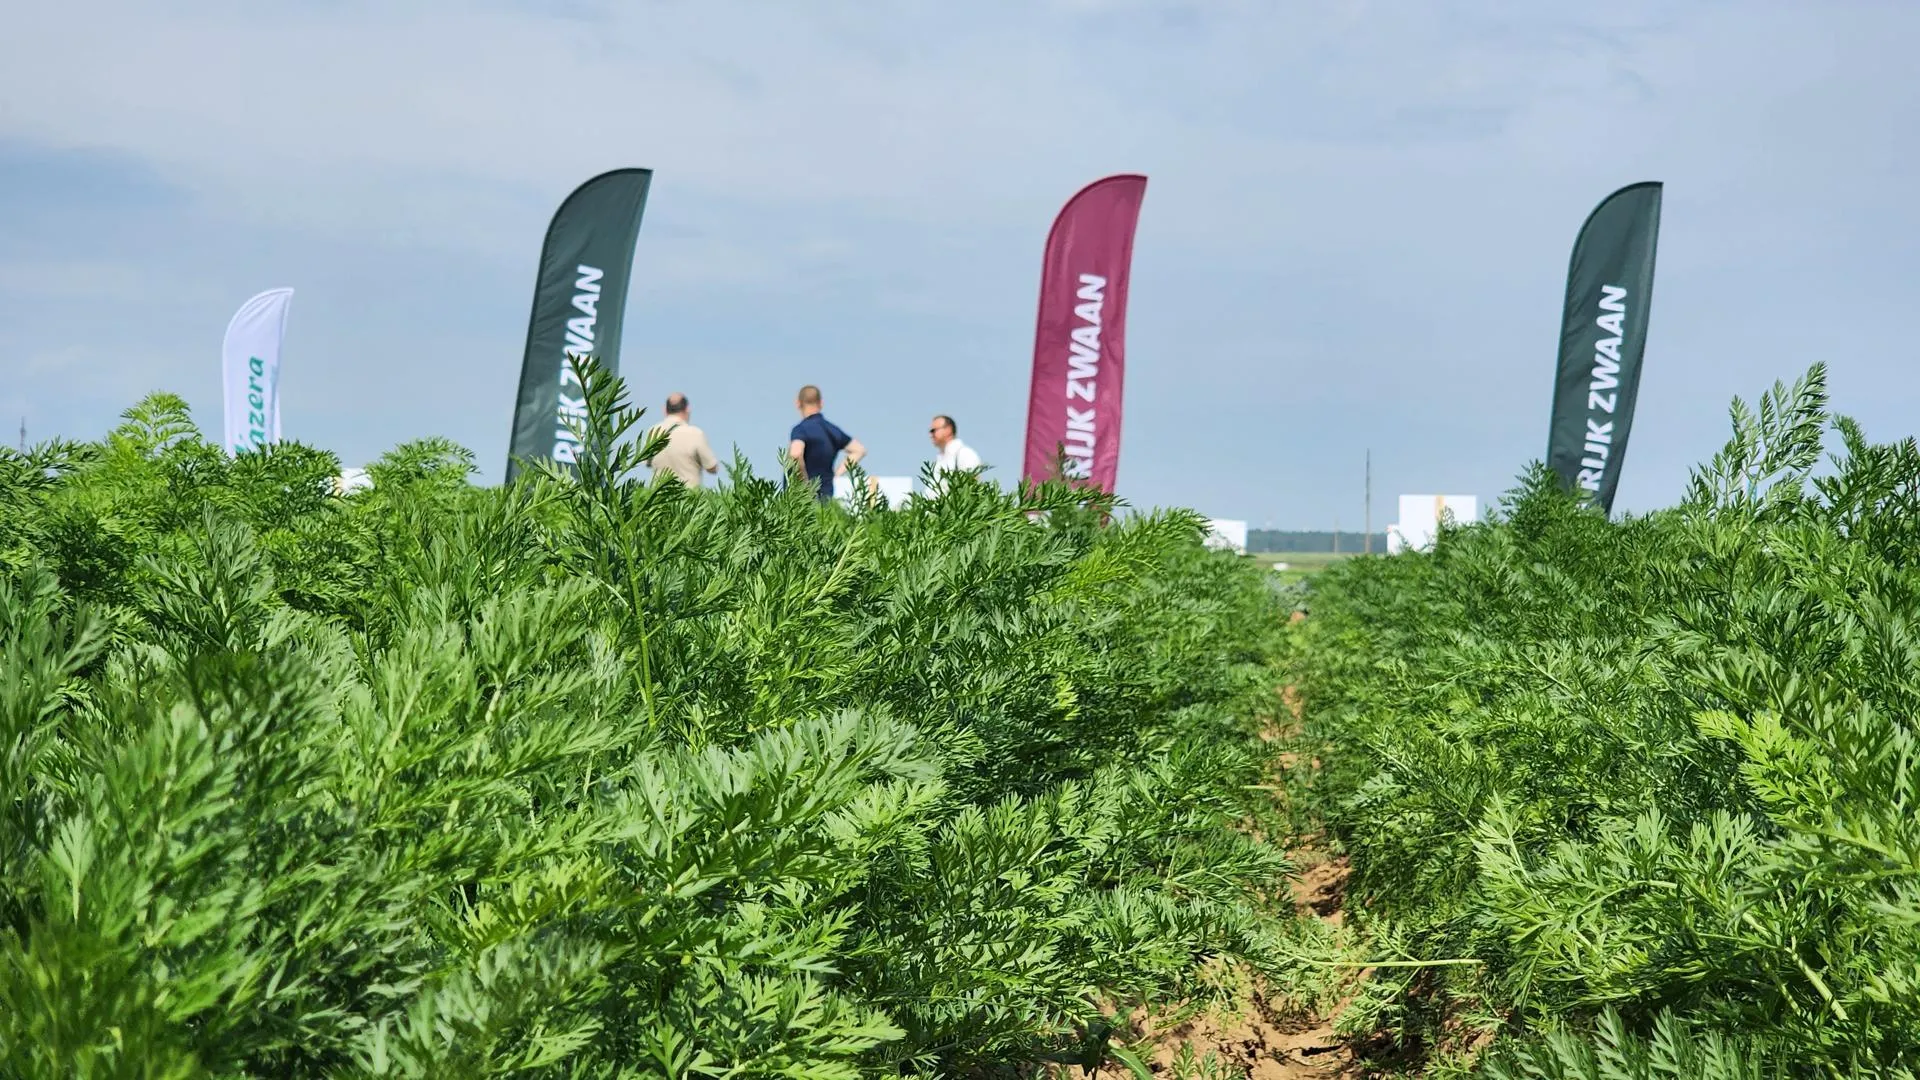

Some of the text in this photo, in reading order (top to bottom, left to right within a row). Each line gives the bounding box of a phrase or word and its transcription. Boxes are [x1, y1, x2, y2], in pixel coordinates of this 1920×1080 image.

[560, 264, 604, 389] ZWAAN
[1066, 273, 1107, 403] ZWAAN
[1576, 284, 1628, 492] RIJK ZWAAN
[234, 356, 266, 454] azera
